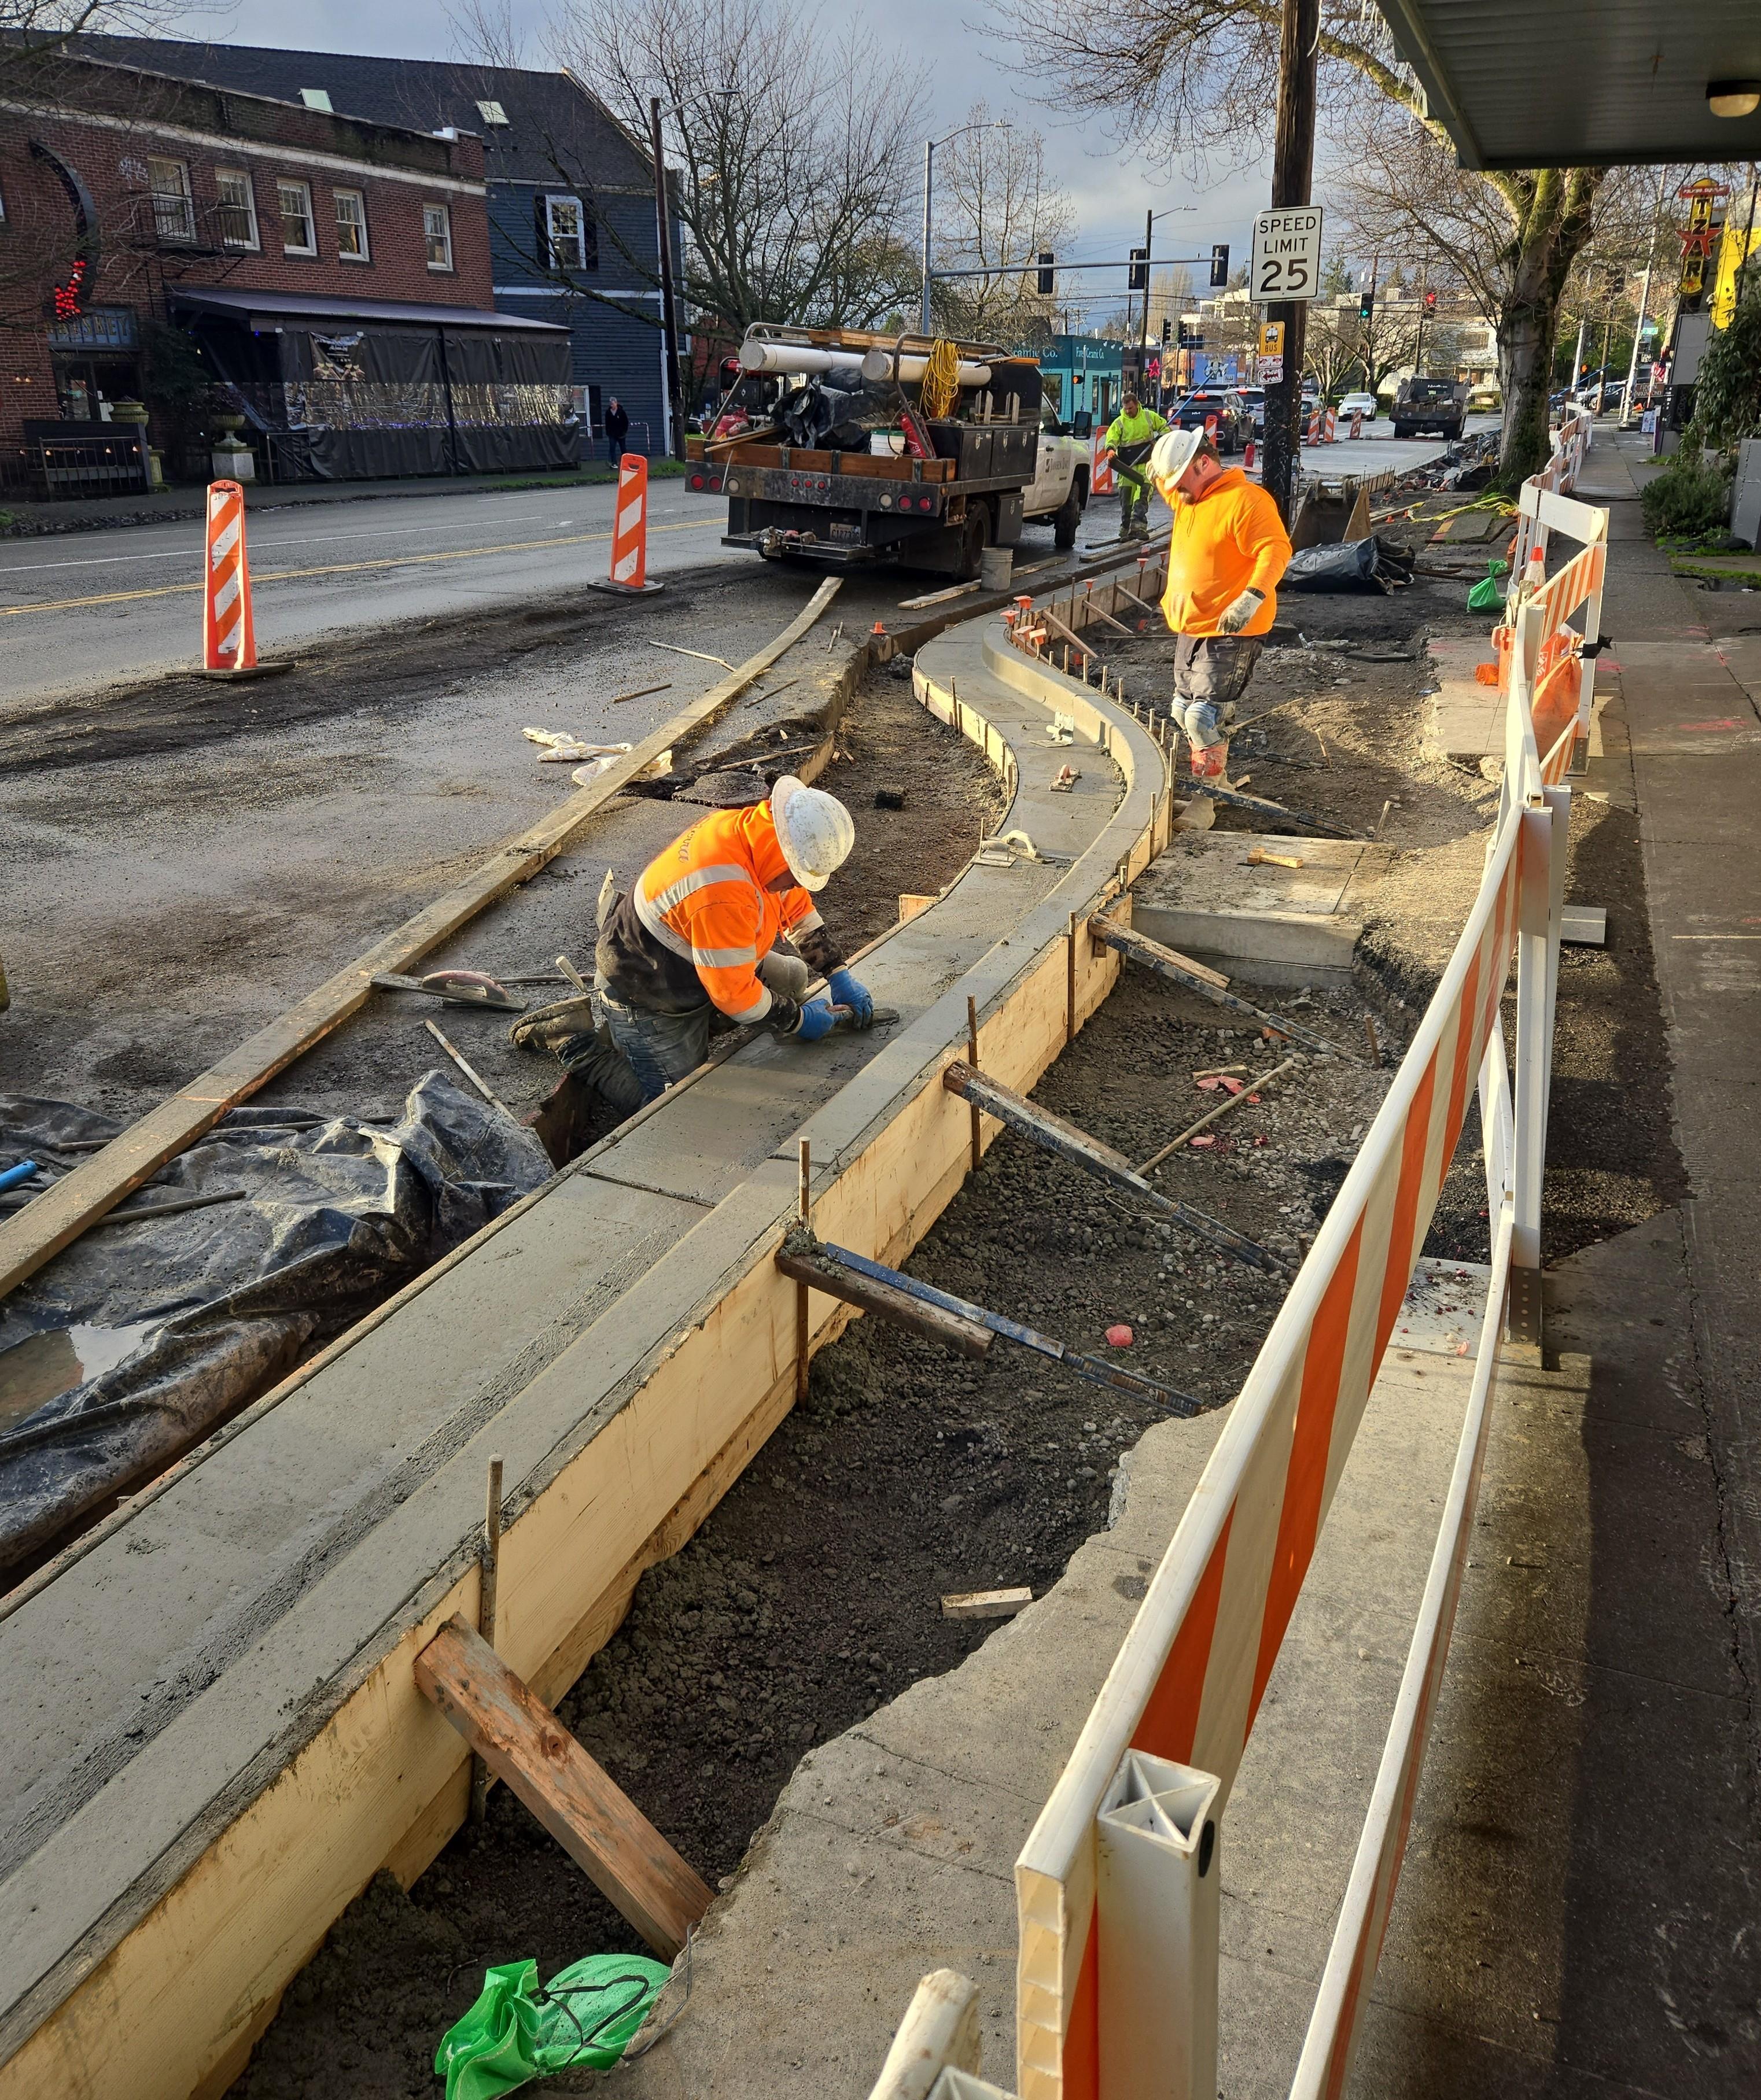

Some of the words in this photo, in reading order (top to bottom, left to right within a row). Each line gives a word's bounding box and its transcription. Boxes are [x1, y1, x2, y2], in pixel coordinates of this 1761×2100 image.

[1259, 216, 1316, 234] SPEED
[1264, 237, 1309, 254] LIMIT
[1260, 258, 1308, 292] 25
[44, 316, 128, 336] HISKEY
[1042, 346, 1058, 357] Co.
[1265, 344, 1278, 352] BUS
